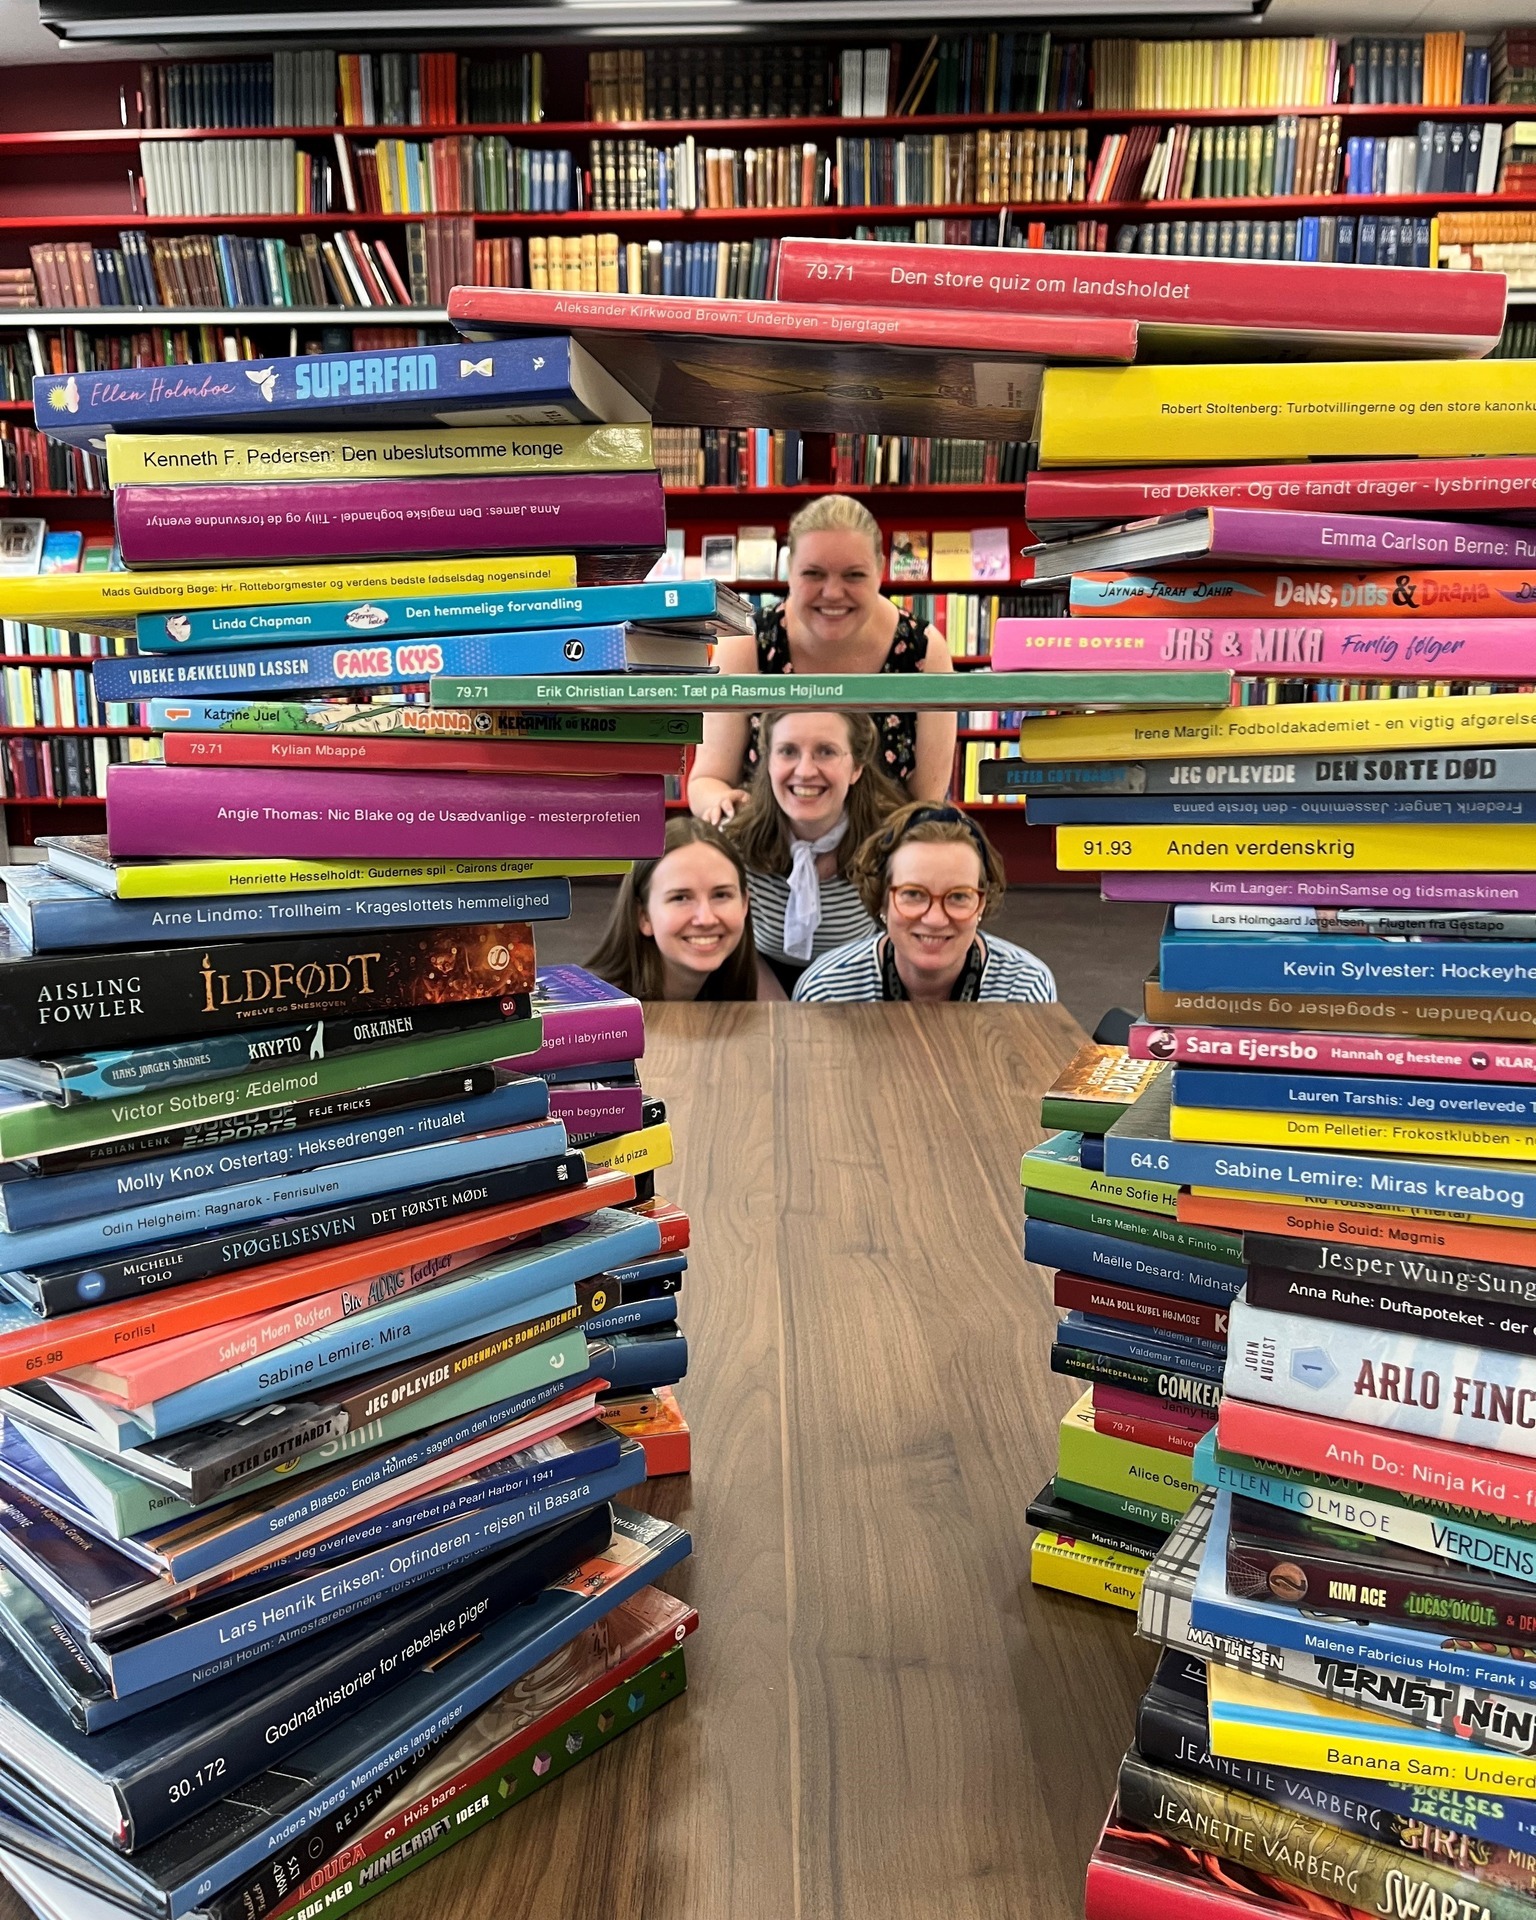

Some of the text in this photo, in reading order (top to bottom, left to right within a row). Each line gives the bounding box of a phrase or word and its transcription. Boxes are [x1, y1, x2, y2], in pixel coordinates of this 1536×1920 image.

[806, 264, 1189, 298] 79.71 Den store quiz om landsholdet
[90, 354, 437, 407] Ellen Holmboe SUPERFAN
[1161, 403, 1201, 413] Robert
[1206, 403, 1281, 416] Stoltenberg:
[1286, 402, 1395, 415] Turbotvillingerne
[1399, 404, 1414, 414] og
[1419, 401, 1442, 411] den
[1447, 402, 1480, 411] store
[144, 442, 562, 466] Kenneth F. Pedersen: Den ubeslutsomme konge
[341, 505, 560, 522] Anna James: Den magiske boghandel
[102, 588, 130, 596] Mads
[133, 586, 183, 596] Guldborg
[187, 584, 217, 595] Bøge:
[240, 580, 326, 591] Rotteborgmester
[330, 580, 343, 589] og
[346, 578, 387, 586] verdens
[390, 576, 425, 585] bedste
[428, 573, 484, 583] fødselsdag
[487, 570, 550, 582] nogensinde!
[212, 597, 582, 629] Linda Chapman Den hemmelige forvandling
[1026, 627, 1465, 662] SOFIE BOYSEN JAS & MIKA Farlig følger
[129, 644, 442, 684] VIBEKE BÆKKELUND LASSEN FAKE KYS
[456, 684, 842, 699] 79.71 Erik Christian Larsen: Tæt på Rasmus Højlund
[204, 708, 280, 722] Katrine Juel
[190, 743, 365, 758] 79.71 Kylian Mbappé
[1084, 839, 1354, 858] 91.93 Anden verdenskrig
[200, 952, 380, 1012] ILDFØDT
[1284, 961, 1335, 975] Kevin
[1341, 962, 1434, 980] Sylvester:
[38, 977, 141, 1002] AISLING
[39, 999, 144, 1025] FOWLER
[575, 1030, 627, 1043] labyrinten
[1187, 1036, 1462, 1064] Sara Ejersbo Hannah og hestene
[111, 1072, 317, 1122] Victor Sotberg: Ædelmod
[577, 1106, 625, 1117] begynder
[117, 1148, 292, 1193] Molly Knox Ostertag:
[1131, 1152, 1523, 1208] 64.6 Sabine Lemire: Miras kreabog
[222, 1187, 488, 1262] SPØGELSESVEN DET FØRSTE MØDE
[1287, 1216, 1444, 1245] Sophie Souid: Møgmis
[123, 1254, 184, 1276] MICHELLE
[138, 1271, 172, 1286] TOLO
[1093, 1251, 1132, 1269] Maëlle
[1136, 1261, 1183, 1281] Desard:
[1288, 1282, 1484, 1327] Anna Ruhe: Duftapoteket
[114, 1324, 156, 1344] Forlist
[26, 1351, 62, 1370] 65.98
[259, 1323, 412, 1390] Sabine Lemire: Mira
[1354, 1358, 1440, 1410] ARLO
[1325, 1444, 1505, 1499] Anh Do: Ninja Kid
[1218, 1467, 1534, 1575] ELLEN HOLMBOE VERDENS
[219, 1620, 256, 1643] Lars
[262, 1594, 316, 1626] Henrik
[321, 1568, 384, 1602] Eriksen:
[390, 1533, 470, 1572] Opfinderen
[1104, 1582, 1136, 1600] Kathy
[1329, 1580, 1386, 1608] KIM ACE
[1305, 1634, 1515, 1685] Malene Fabricius Holm: Frank
[168, 1598, 490, 1804] 30.172 Godnathistorier for rebelske piger
[1314, 1655, 1452, 1718] TERNET
[268, 1704, 463, 1848] Anders Nyberg: Menneskets lange rejser
[1327, 1748, 1455, 1777] Banana Sam:
[358, 1794, 490, 1887] MINECRAFT IDEER
[1154, 1794, 1358, 1894] JEANETTE VARBERG
